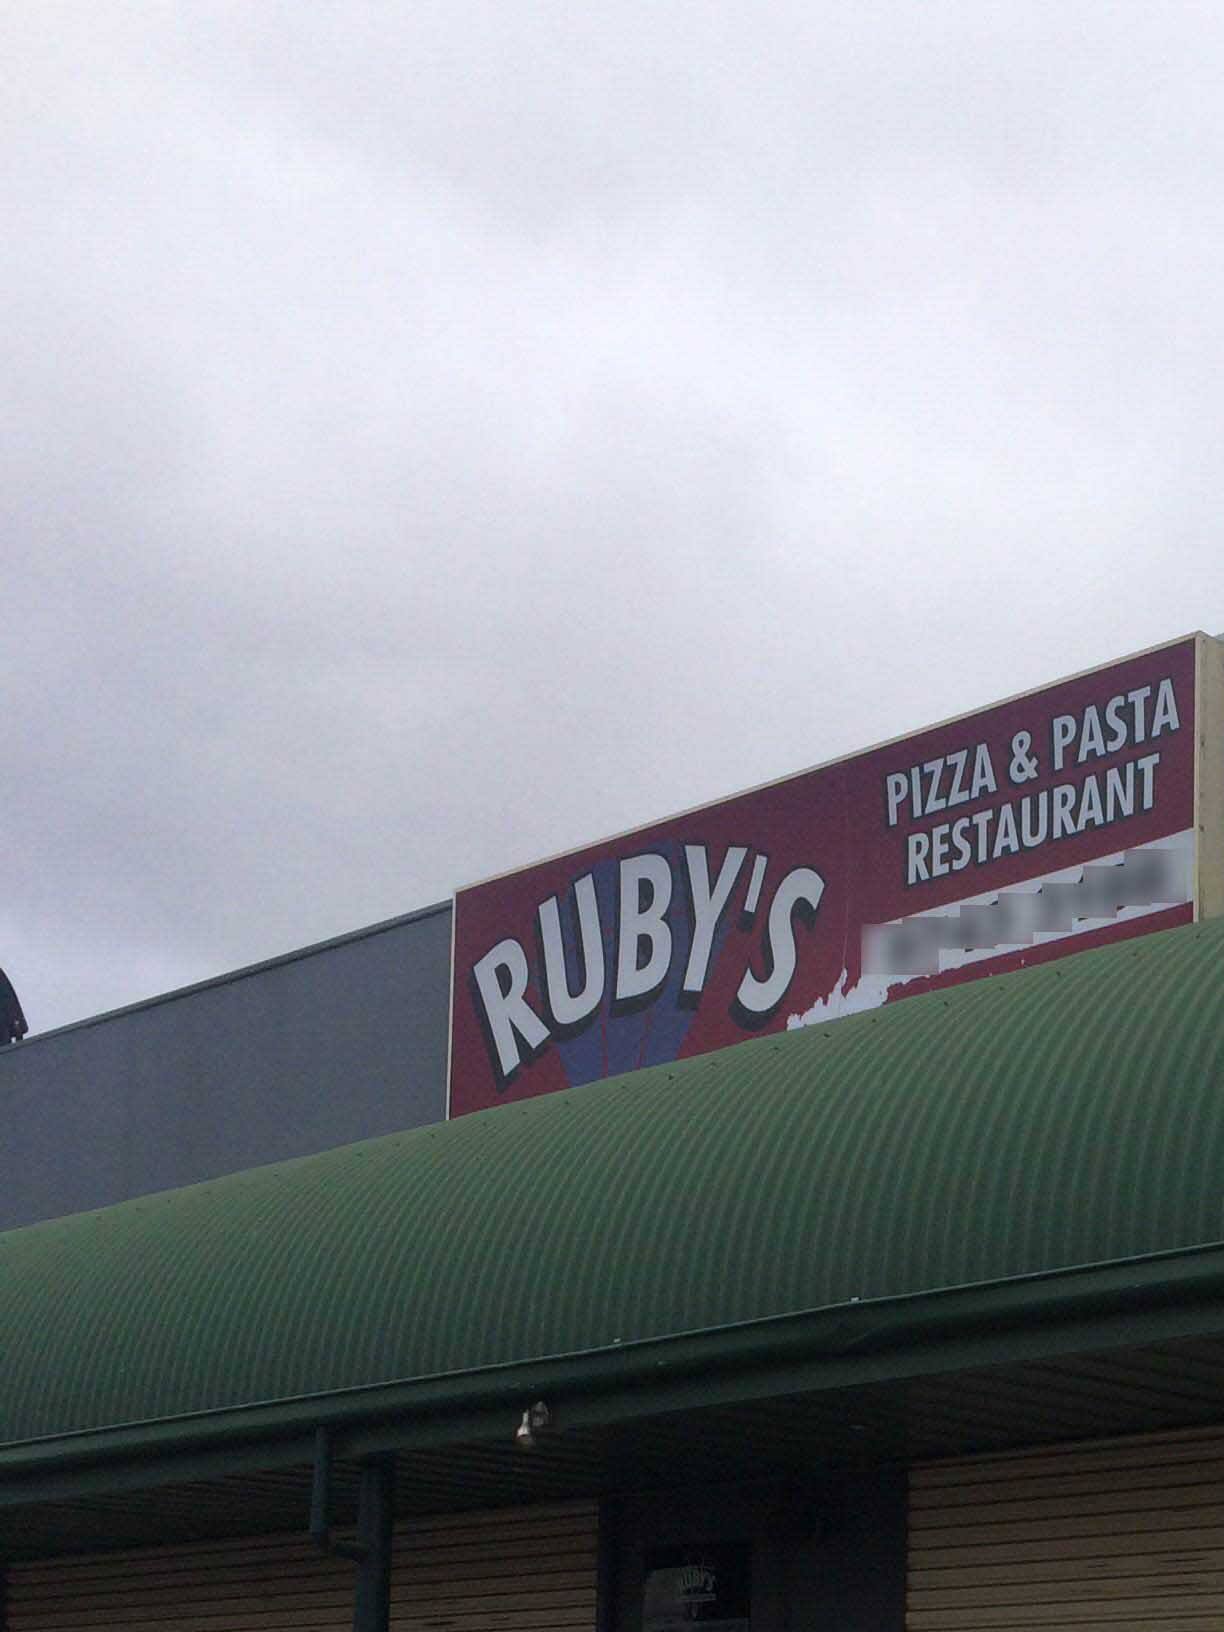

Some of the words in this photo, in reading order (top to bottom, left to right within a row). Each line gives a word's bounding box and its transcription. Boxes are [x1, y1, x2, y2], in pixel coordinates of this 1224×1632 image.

[886, 743, 998, 827] PIZZA
[1009, 730, 1039, 784] &
[1052, 678, 1180, 771] PASTA
[906, 752, 1161, 886] RESTAURANT
[473, 845, 825, 1077] RUBY'S
